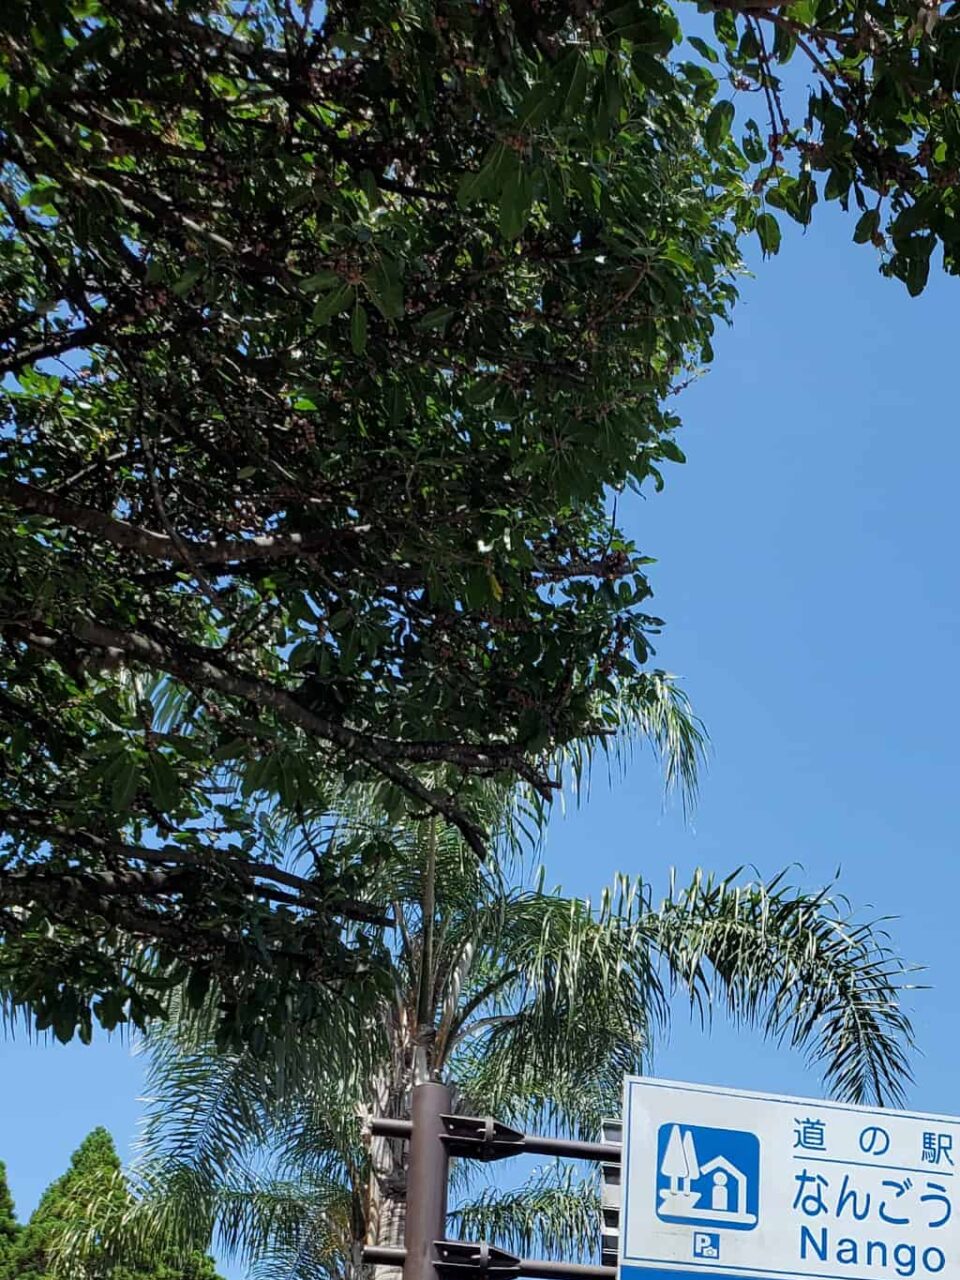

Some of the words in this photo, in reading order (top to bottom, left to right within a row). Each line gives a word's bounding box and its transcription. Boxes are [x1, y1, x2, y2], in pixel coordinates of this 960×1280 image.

[793, 1118, 955, 1166] 道の駅
[792, 1169, 952, 1228] なんごう
[799, 1225, 946, 1276] Nango
